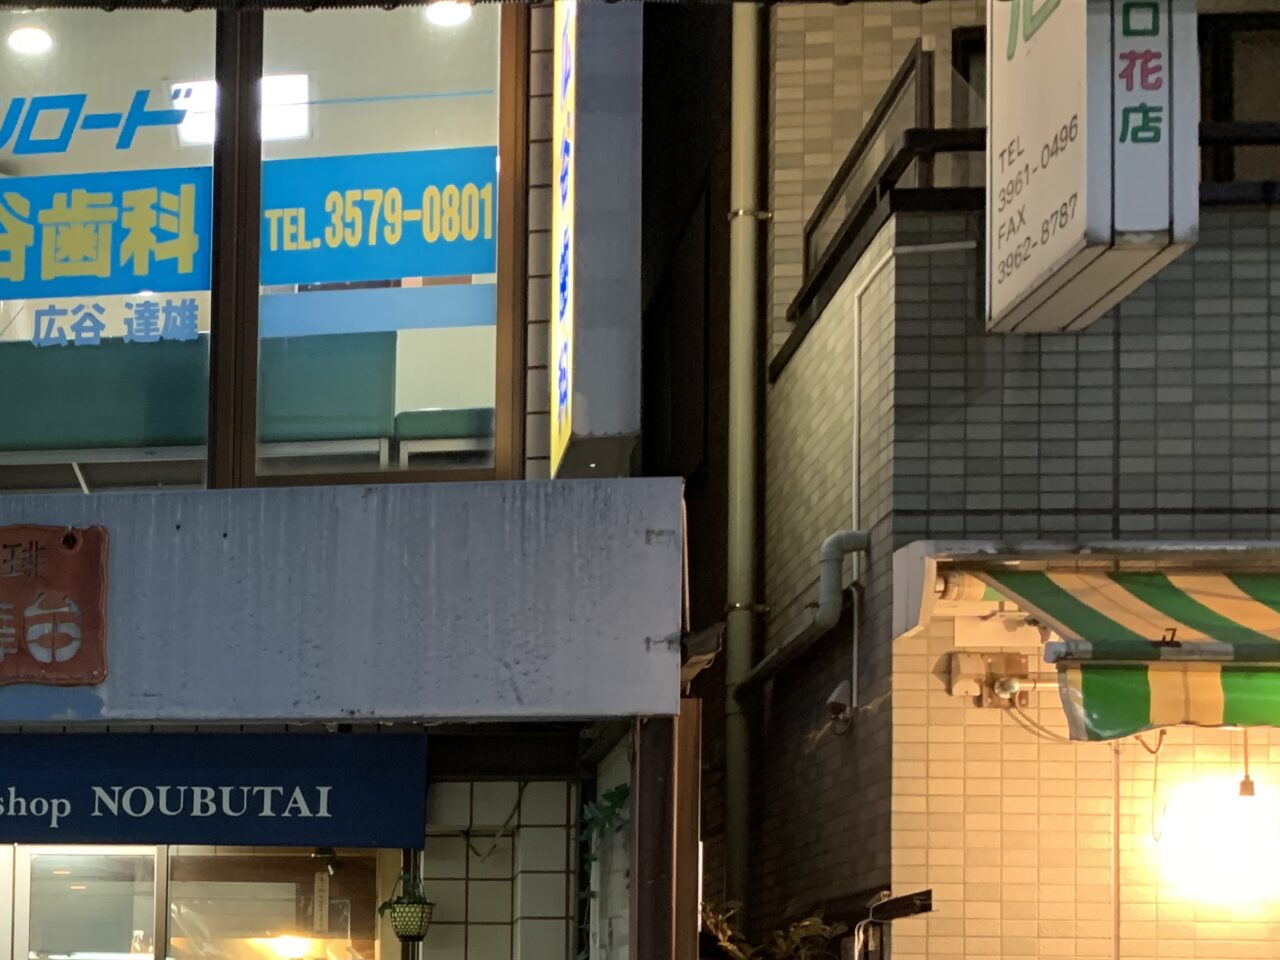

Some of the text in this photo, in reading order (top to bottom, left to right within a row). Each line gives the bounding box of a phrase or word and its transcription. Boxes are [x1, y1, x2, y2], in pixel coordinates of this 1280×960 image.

[998, 137, 1025, 173] TEL
[998, 114, 1078, 213] 3961-0496
[997, 205, 1026, 249] FAX
[997, 192, 1078, 284] 3962-8787
[31, 302, 106, 349] 広谷
[122, 298, 200, 345] 達雄
[91, 785, 333, 818] NOUBUTAI
